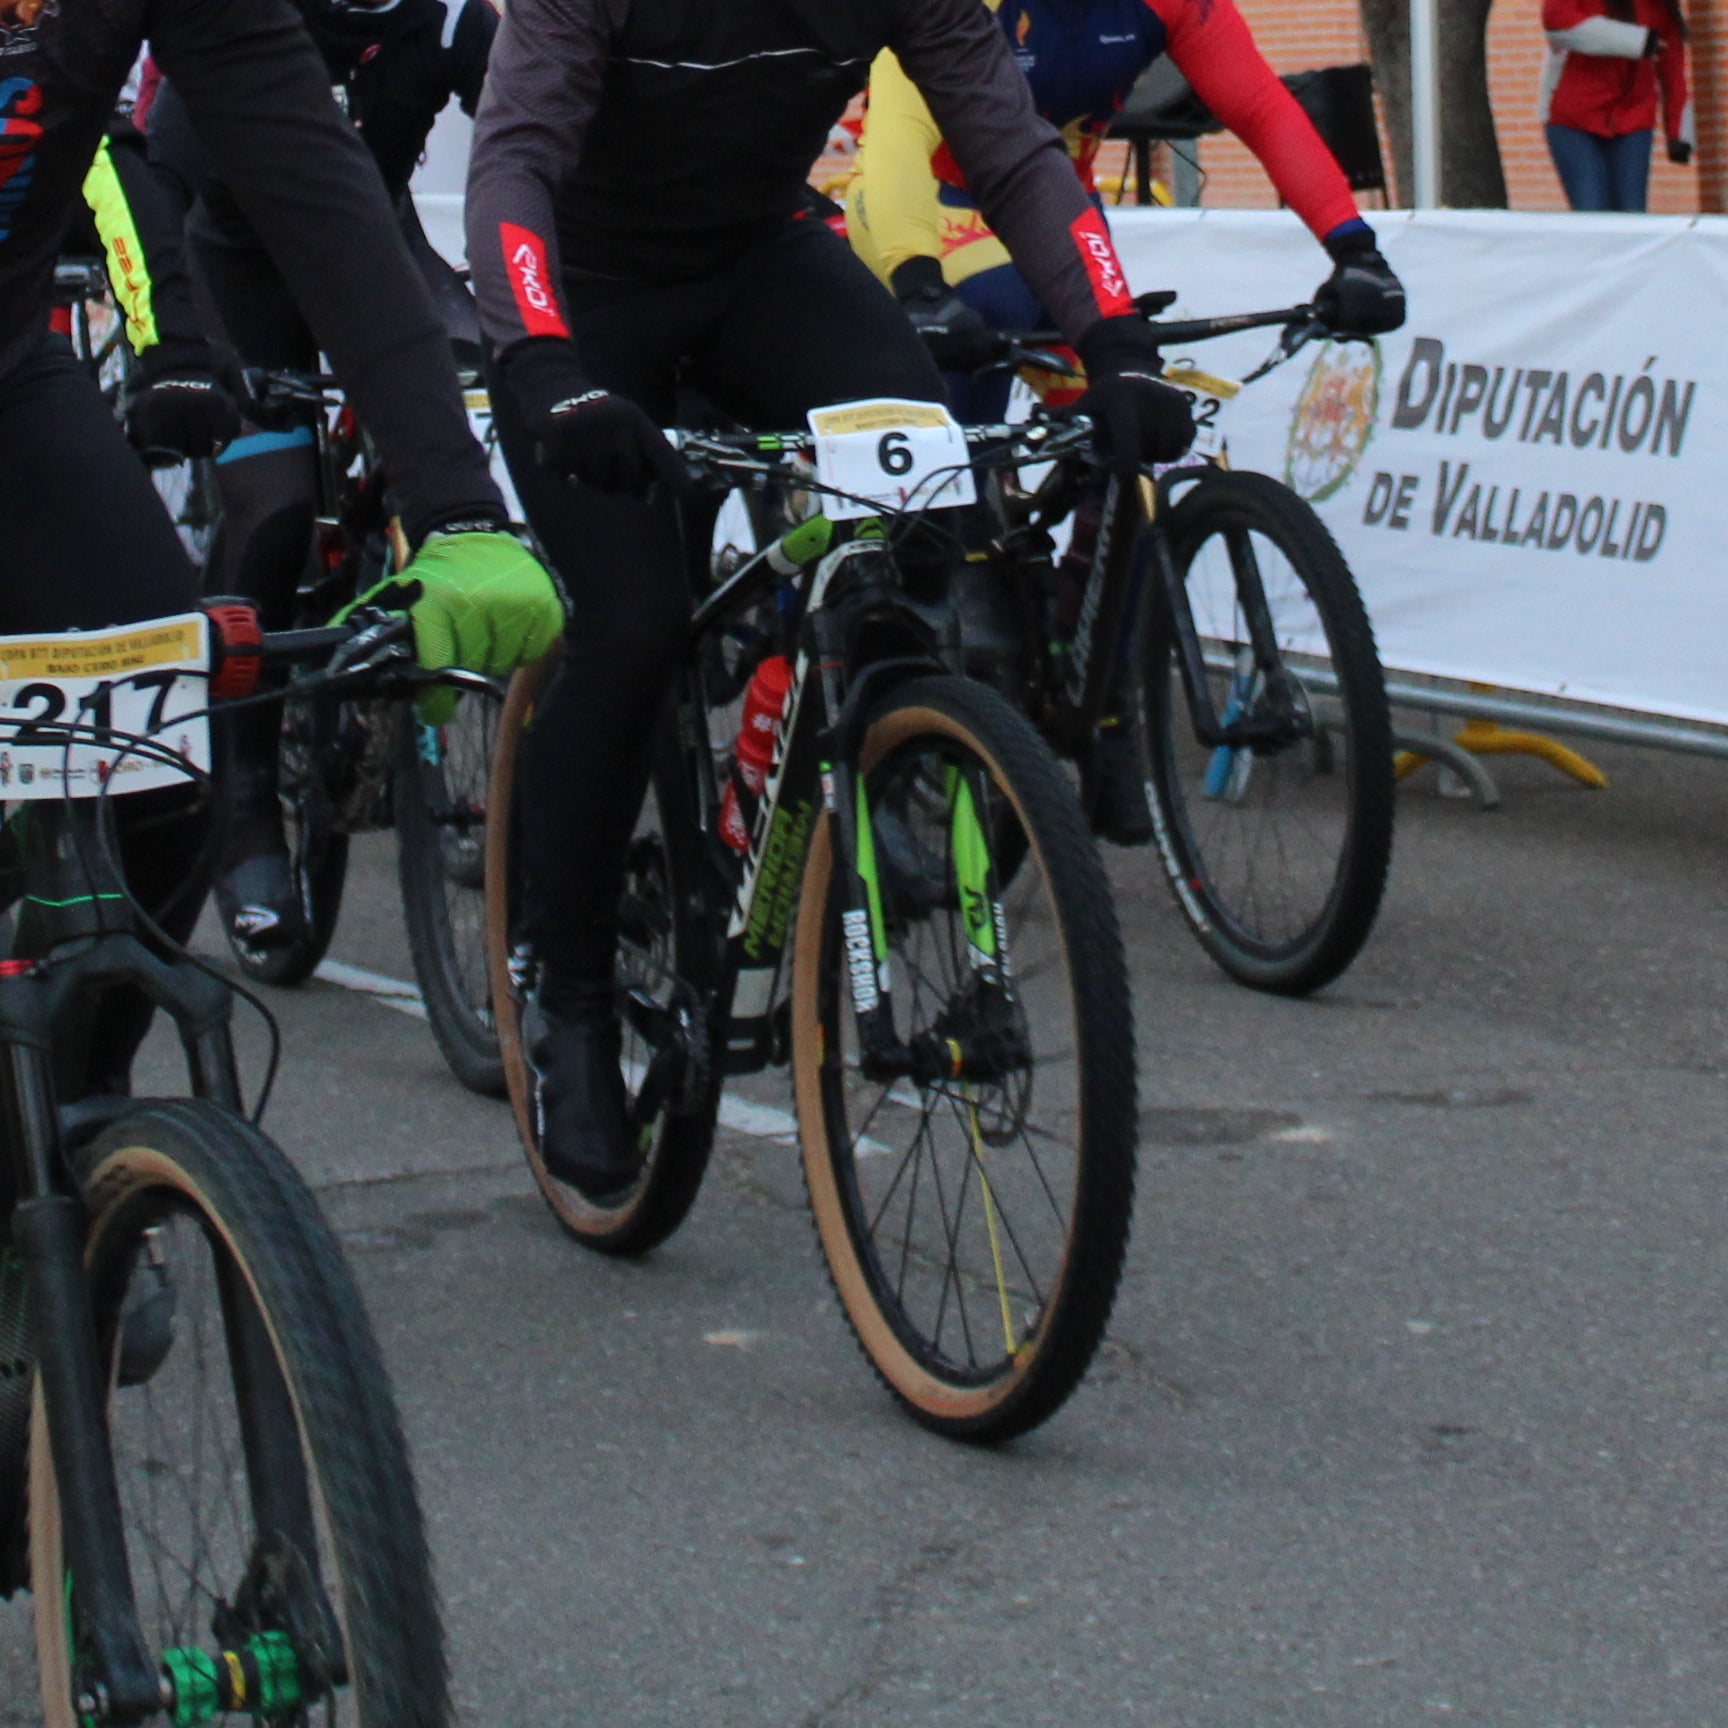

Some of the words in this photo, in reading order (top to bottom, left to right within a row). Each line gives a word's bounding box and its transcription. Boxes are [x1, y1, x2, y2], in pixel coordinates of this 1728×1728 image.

[1393, 335, 1697, 458] DIPUTACIÓN
[878, 431, 914, 477] 6
[1362, 469, 1414, 531] DE
[1428, 459, 1669, 563] VALLADOLID
[12, 668, 179, 746] 217
